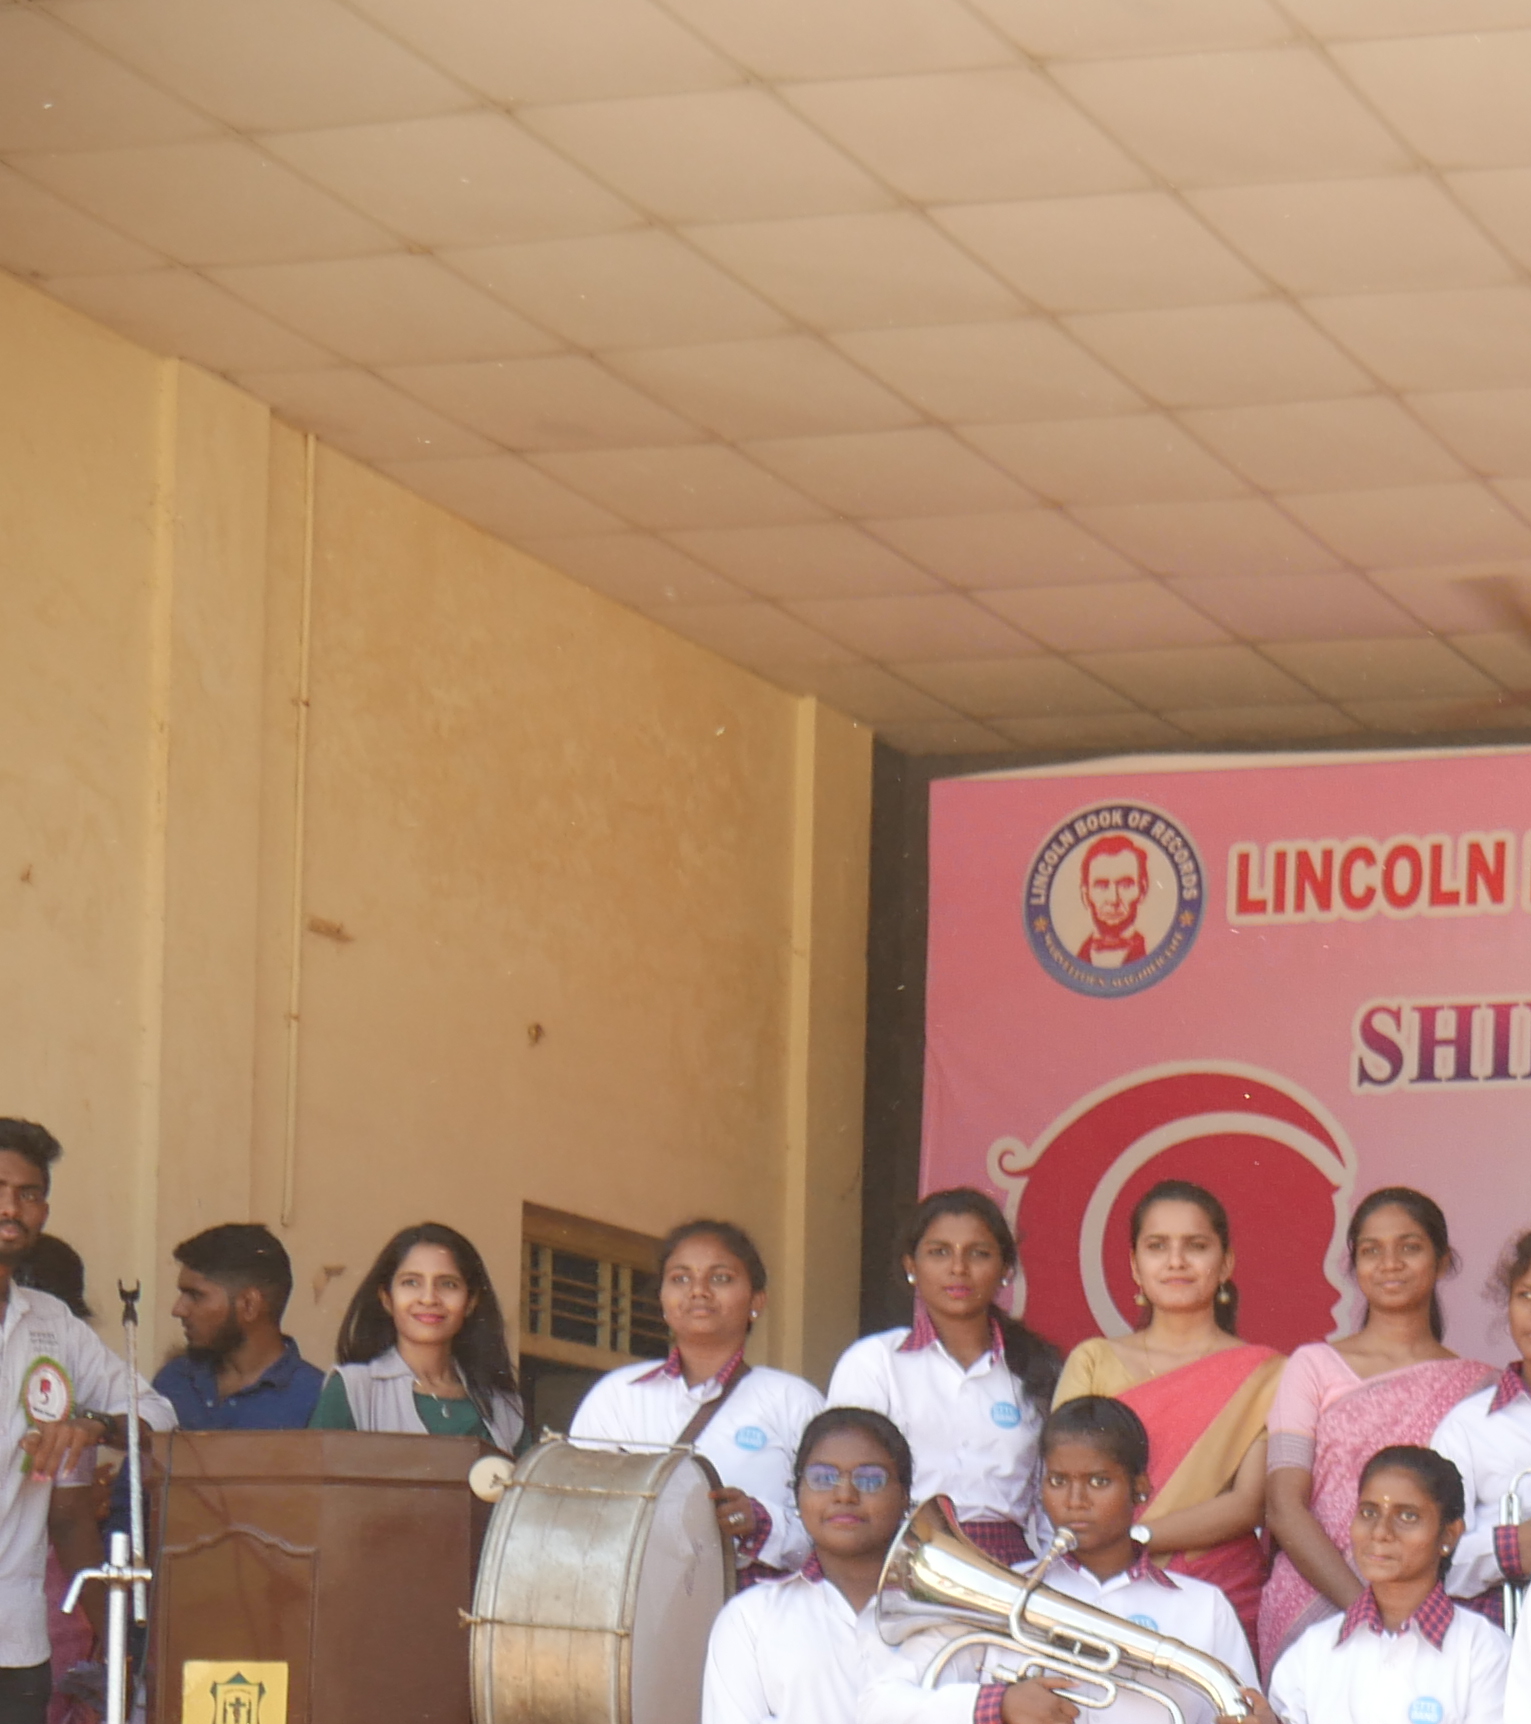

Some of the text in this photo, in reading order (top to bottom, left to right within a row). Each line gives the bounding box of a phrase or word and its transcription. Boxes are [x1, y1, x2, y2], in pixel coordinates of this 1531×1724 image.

[1030, 809, 1198, 905] LINCOLN BOOK OF RECORDS
[1235, 839, 1507, 915] LINCOLN
